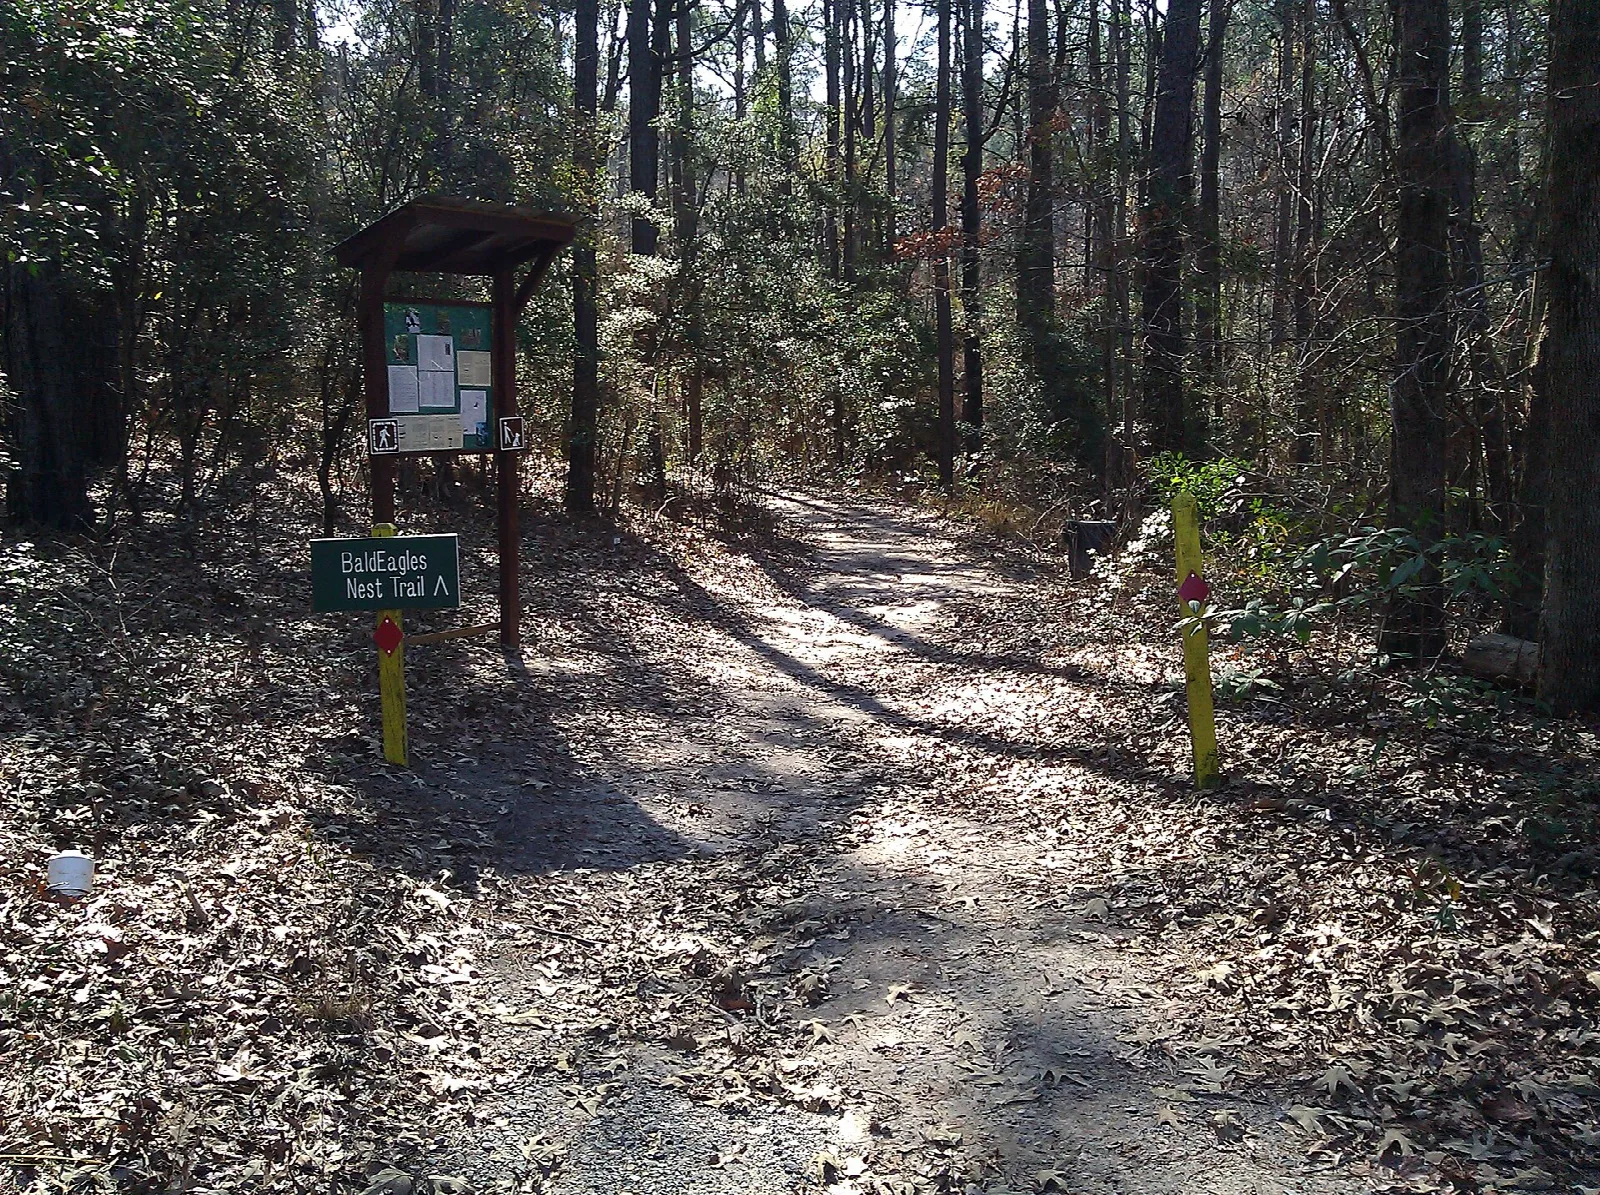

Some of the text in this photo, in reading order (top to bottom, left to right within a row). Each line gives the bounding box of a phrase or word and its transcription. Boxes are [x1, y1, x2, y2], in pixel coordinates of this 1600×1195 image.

[341, 550, 428, 575] BaldEagles
[346, 575, 425, 599] Nest Trail
